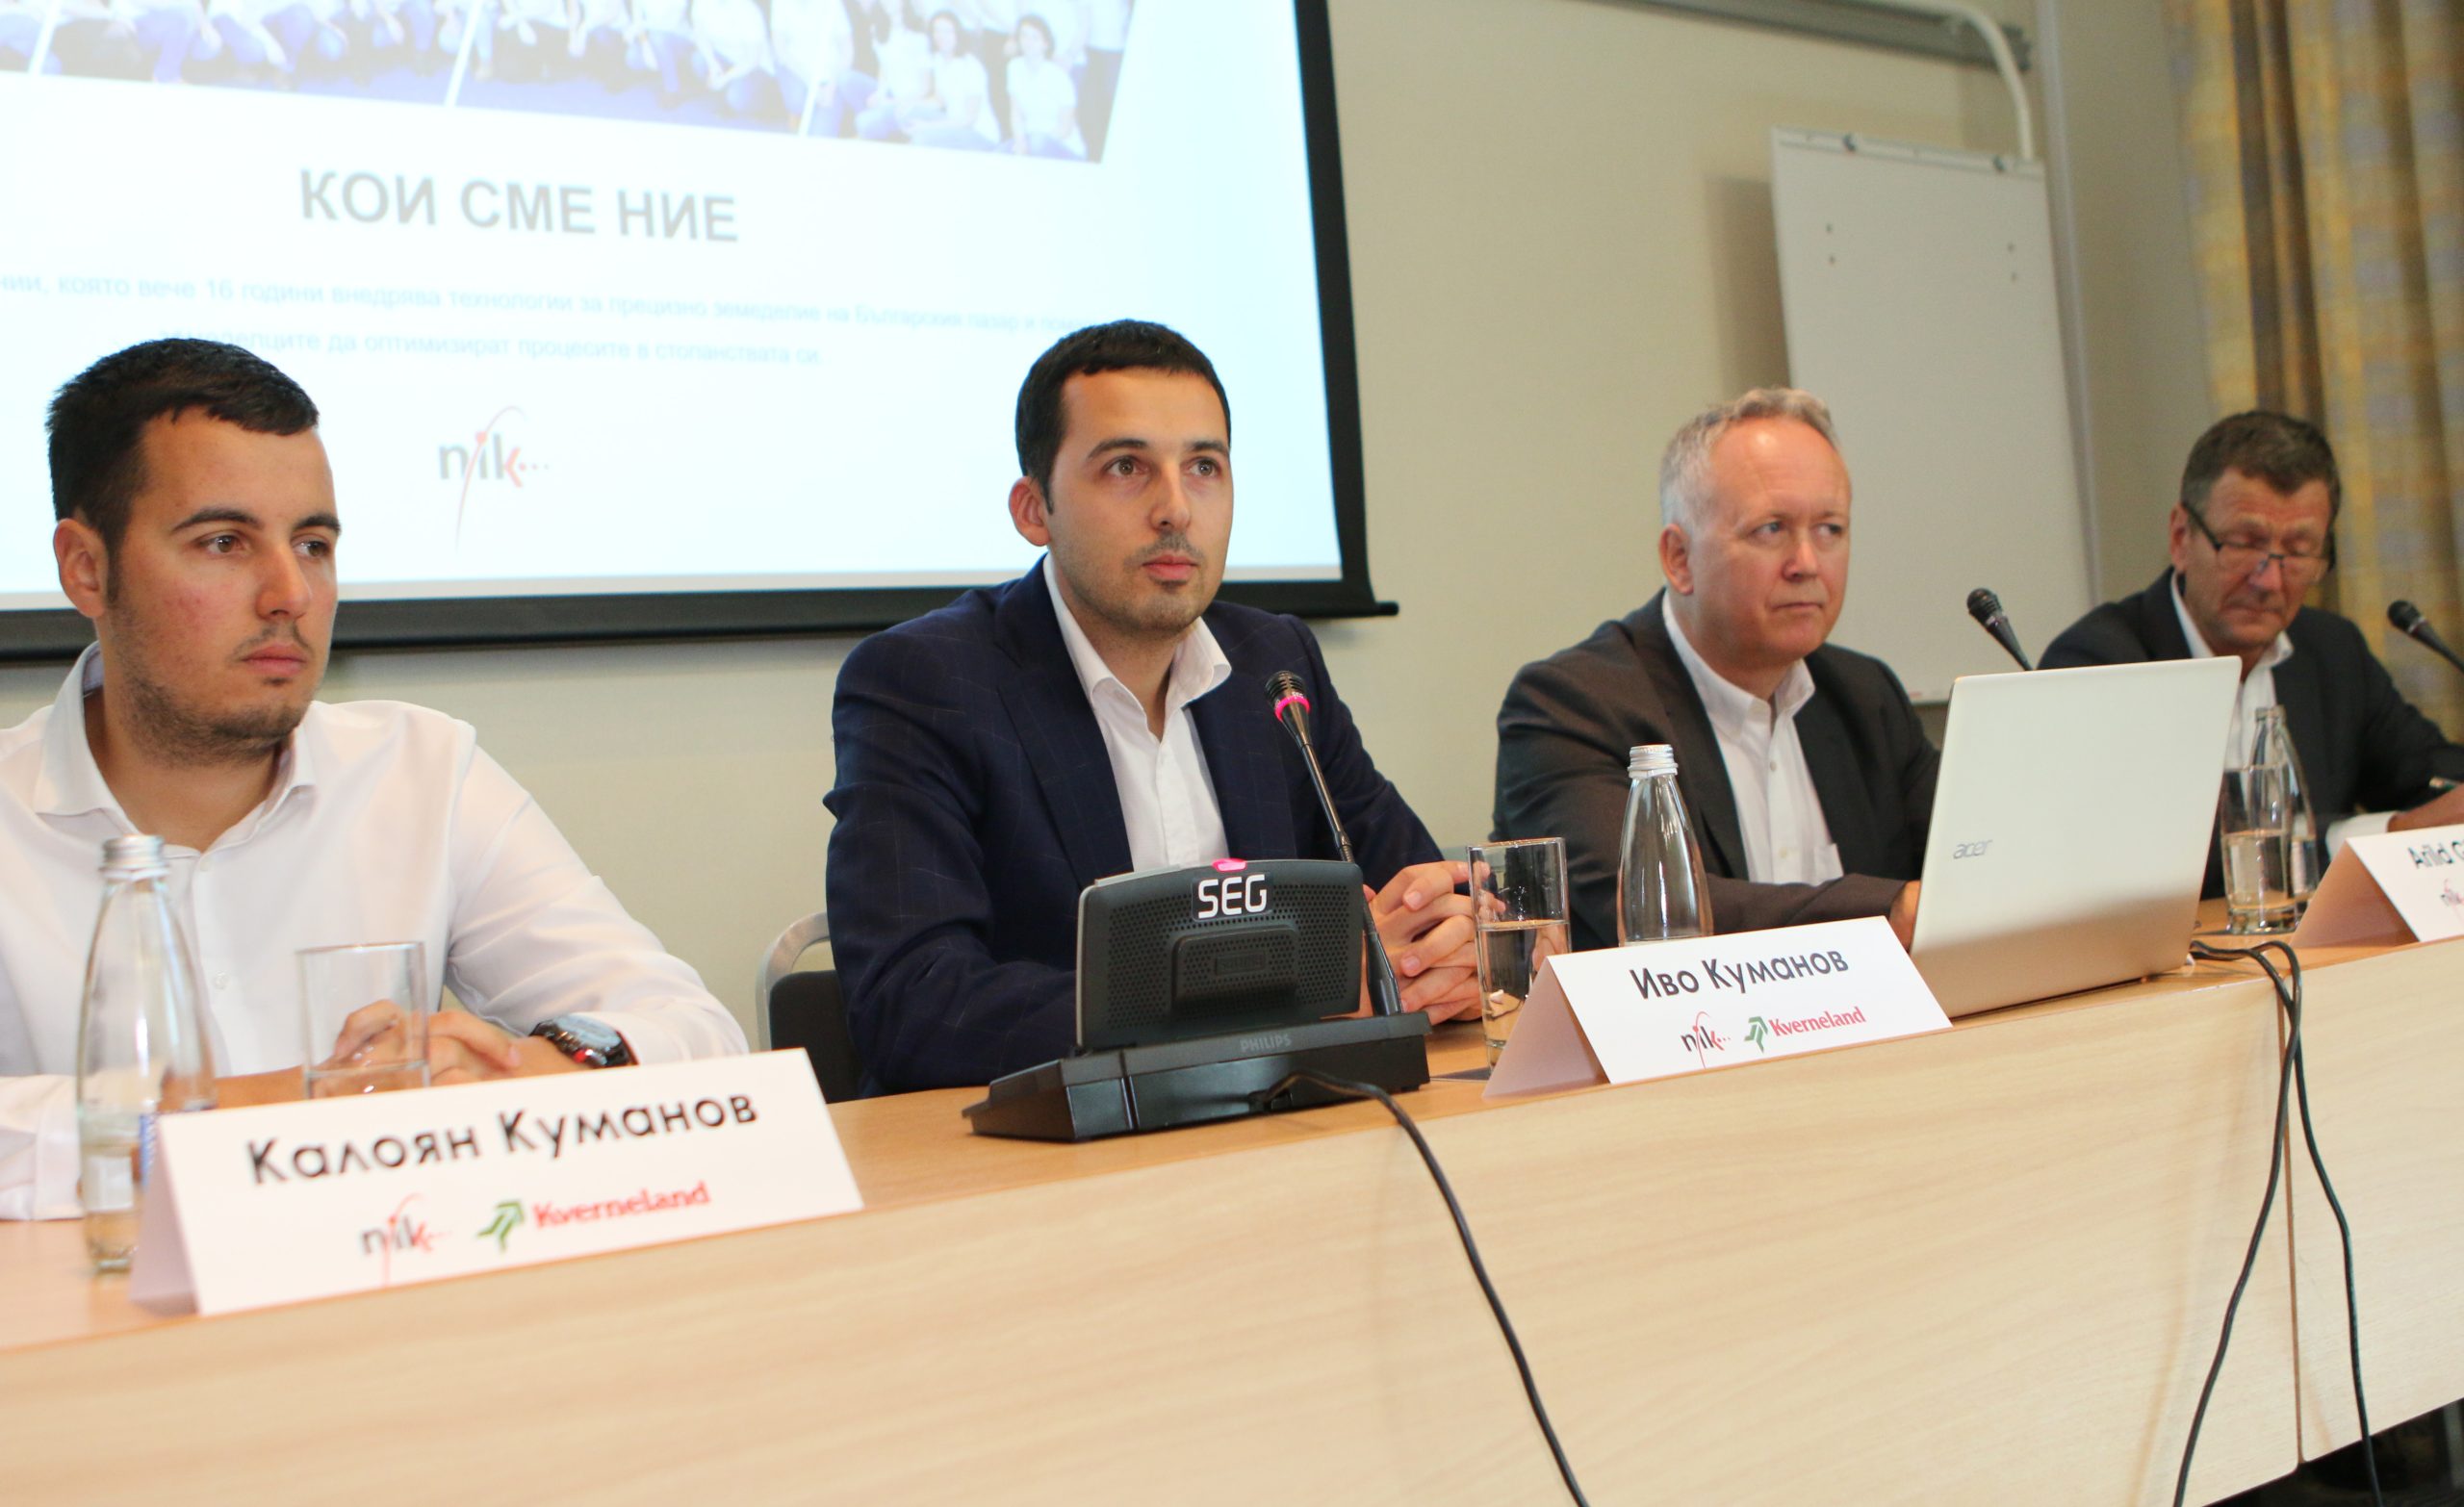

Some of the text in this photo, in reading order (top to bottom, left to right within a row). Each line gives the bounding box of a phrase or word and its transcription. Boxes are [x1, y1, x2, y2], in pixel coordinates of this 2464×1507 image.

[300, 167, 739, 243] КОИ СМЕ НИЕ
[138, 278, 197, 298] вече
[205, 277, 234, 299] 16
[242, 283, 323, 306] години
[331, 286, 441, 310] внедрява
[448, 291, 576, 311] технологии
[579, 294, 603, 312] за
[826, 306, 850, 323] на
[327, 334, 357, 354] да
[364, 334, 510, 358] оптимизират
[517, 338, 630, 362] процесите
[654, 340, 790, 366] стопанствата
[1952, 838, 1993, 859] acer
[1197, 874, 1268, 919] SEG
[1629, 951, 1849, 1000] Иво Куманов
[1240, 1034, 1293, 1054] PHILIPS
[1767, 1006, 1867, 1037] Kverneland
[246, 1093, 758, 1186] Калоян Куманов
[534, 1181, 711, 1229] Kverneland
